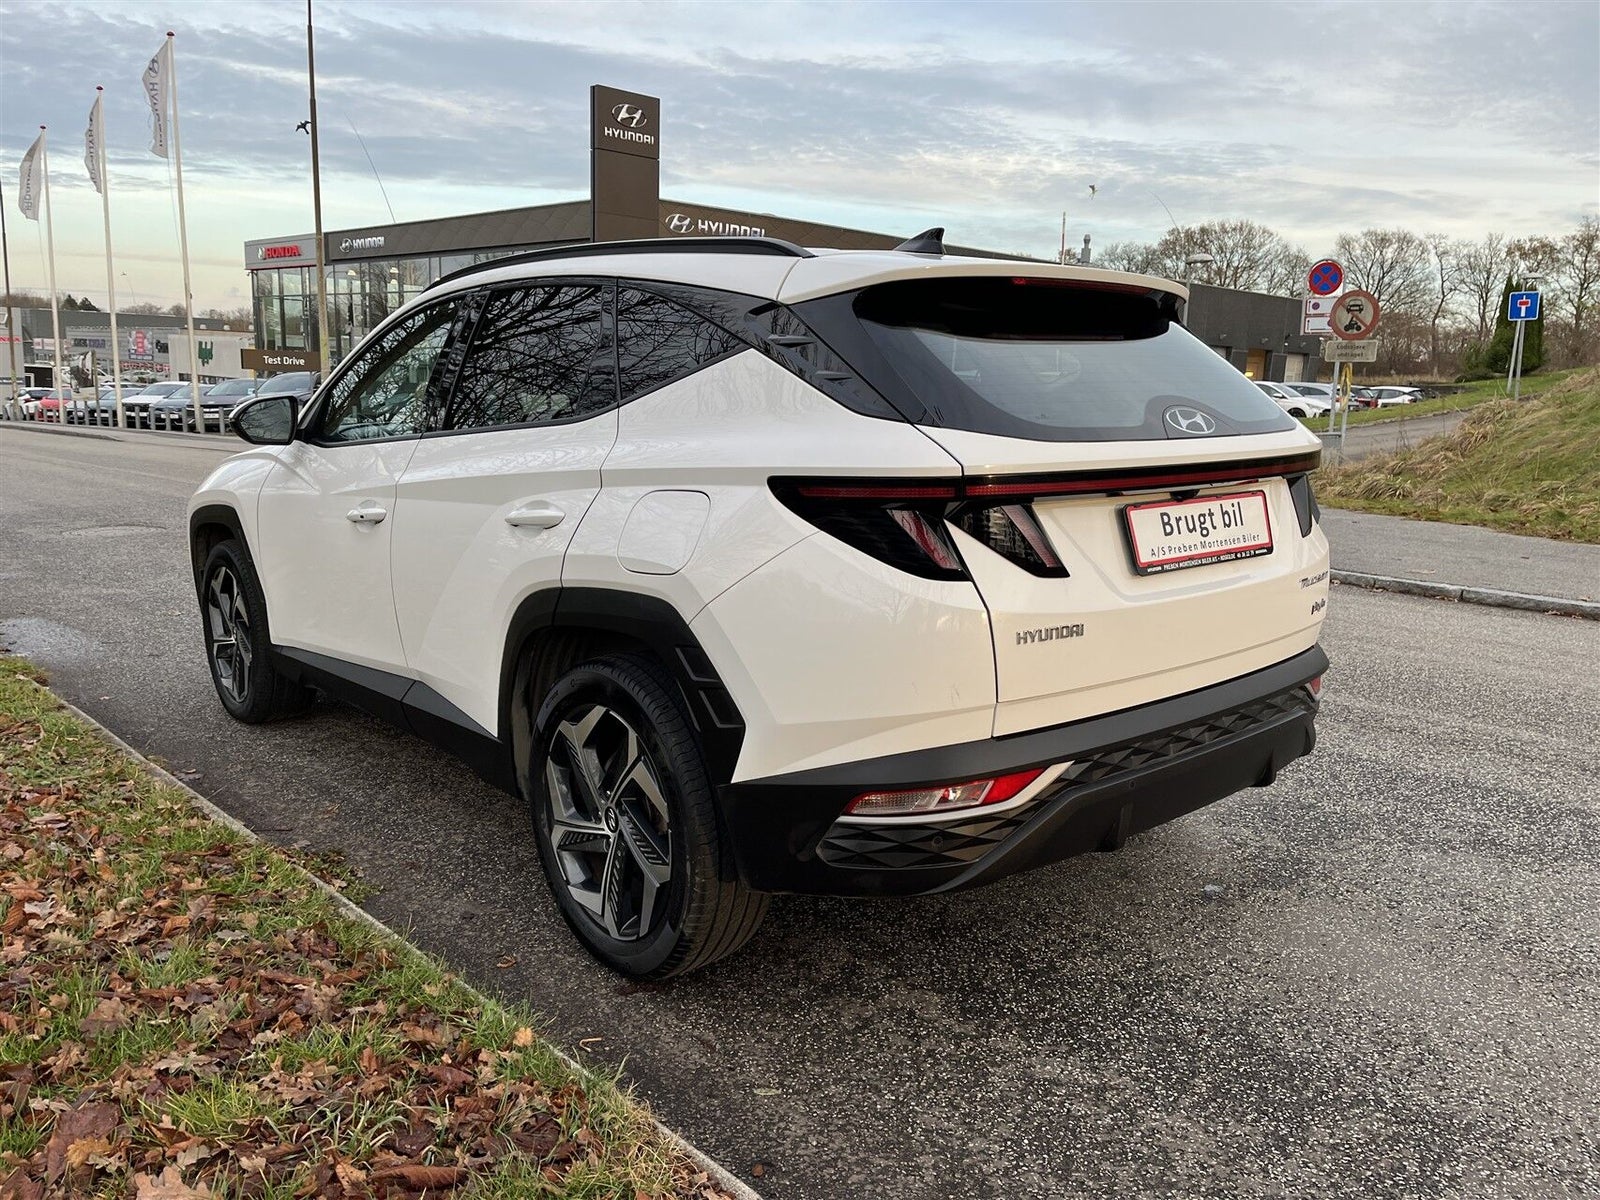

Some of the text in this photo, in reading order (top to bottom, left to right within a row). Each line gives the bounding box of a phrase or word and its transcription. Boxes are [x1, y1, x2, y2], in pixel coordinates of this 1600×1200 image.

[604, 126, 655, 146] HYUNDAI
[698, 218, 766, 238] HYUNDAI
[265, 245, 301, 260] HONDA
[352, 236, 385, 249] HYUNDAI
[263, 355, 305, 366] Test Drive
[1160, 501, 1244, 538] Brugt bil
[1150, 546, 1166, 559] A/S
[1168, 543, 1199, 555] Preben
[1200, 537, 1242, 552] Mortensen
[1243, 533, 1261, 543] Biler
[1015, 622, 1085, 645] HYUNDAI
